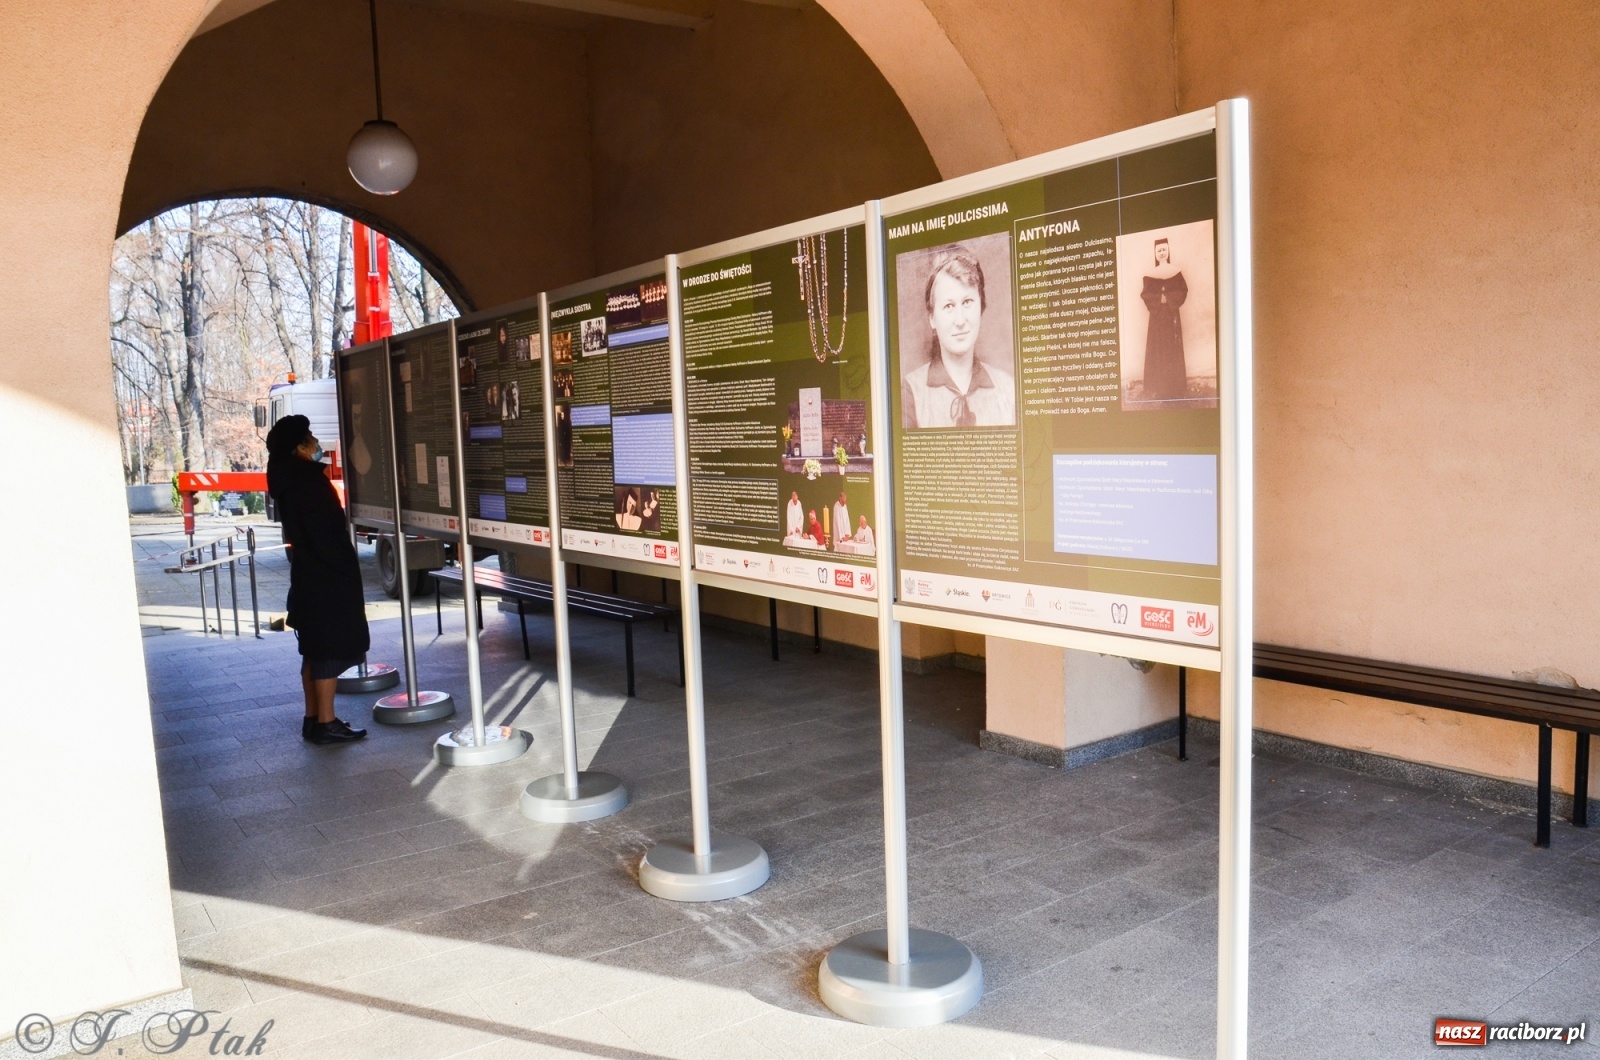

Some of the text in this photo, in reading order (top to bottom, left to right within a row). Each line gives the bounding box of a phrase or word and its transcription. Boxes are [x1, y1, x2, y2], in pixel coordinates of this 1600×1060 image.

[888, 202, 1008, 240] MAM NA IMIĘ DULCISSIMA
[1019, 219, 1080, 242] ANTYFONA
[682, 264, 752, 288] W DRODZE DO ŚWIĘTOŚCI
[1144, 610, 1171, 624] GOŚĆ
[1187, 612, 1206, 629] eM
